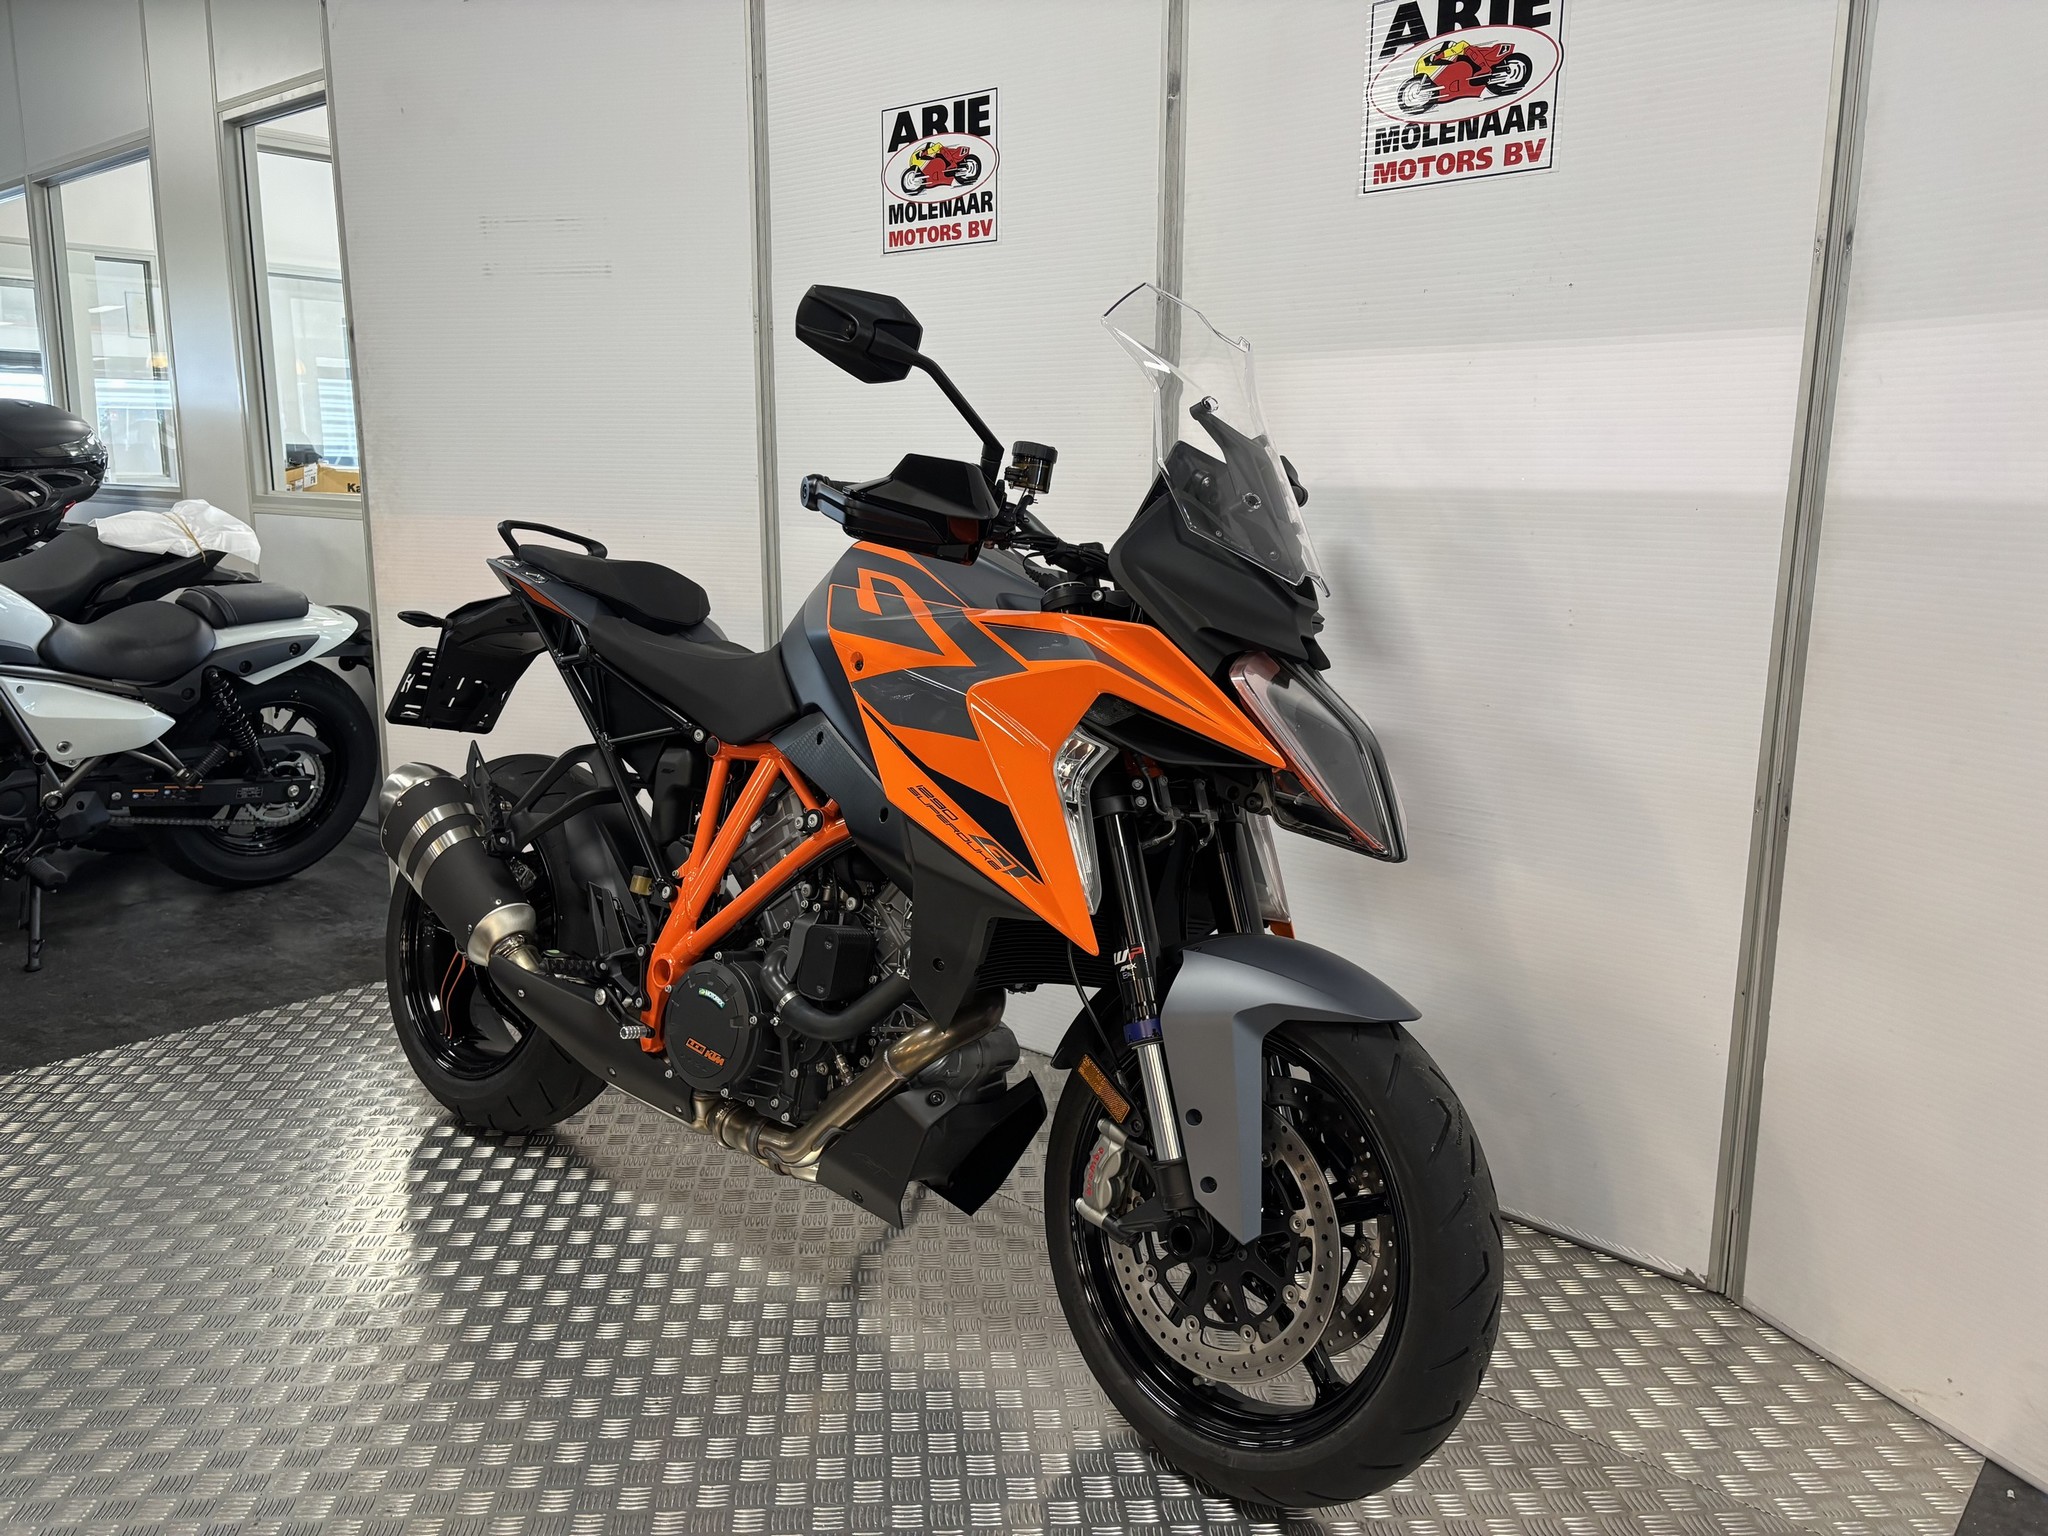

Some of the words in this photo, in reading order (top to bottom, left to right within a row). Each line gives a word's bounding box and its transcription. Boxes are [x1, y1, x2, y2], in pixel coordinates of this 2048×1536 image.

[888, 95, 991, 153] ARIE
[1374, 100, 1549, 155] MOLENAAR
[1373, 146, 1493, 185] MOTORS
[1503, 138, 1547, 167] BV
[888, 190, 994, 225] MOLENAAR
[888, 222, 962, 248] MOTORS
[968, 218, 994, 239] BV
[916, 784, 959, 821] 1290
[1113, 945, 1146, 966] WP
[704, 1049, 726, 1067] KTM
